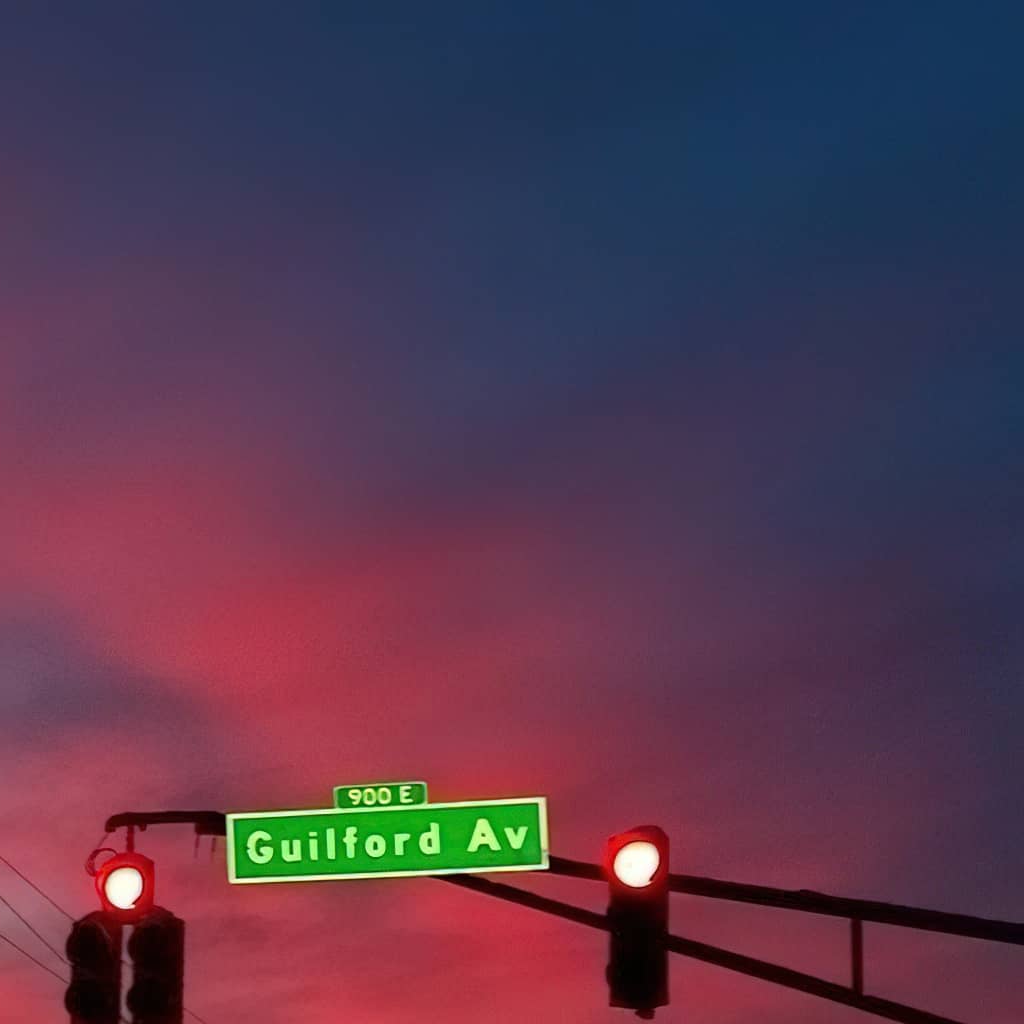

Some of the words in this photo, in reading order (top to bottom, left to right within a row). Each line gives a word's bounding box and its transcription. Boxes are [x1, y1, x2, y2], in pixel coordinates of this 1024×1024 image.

[348, 787, 392, 806] 900
[399, 785, 414, 804] E
[246, 822, 441, 865] Guilford
[466, 818, 529, 853] Av
